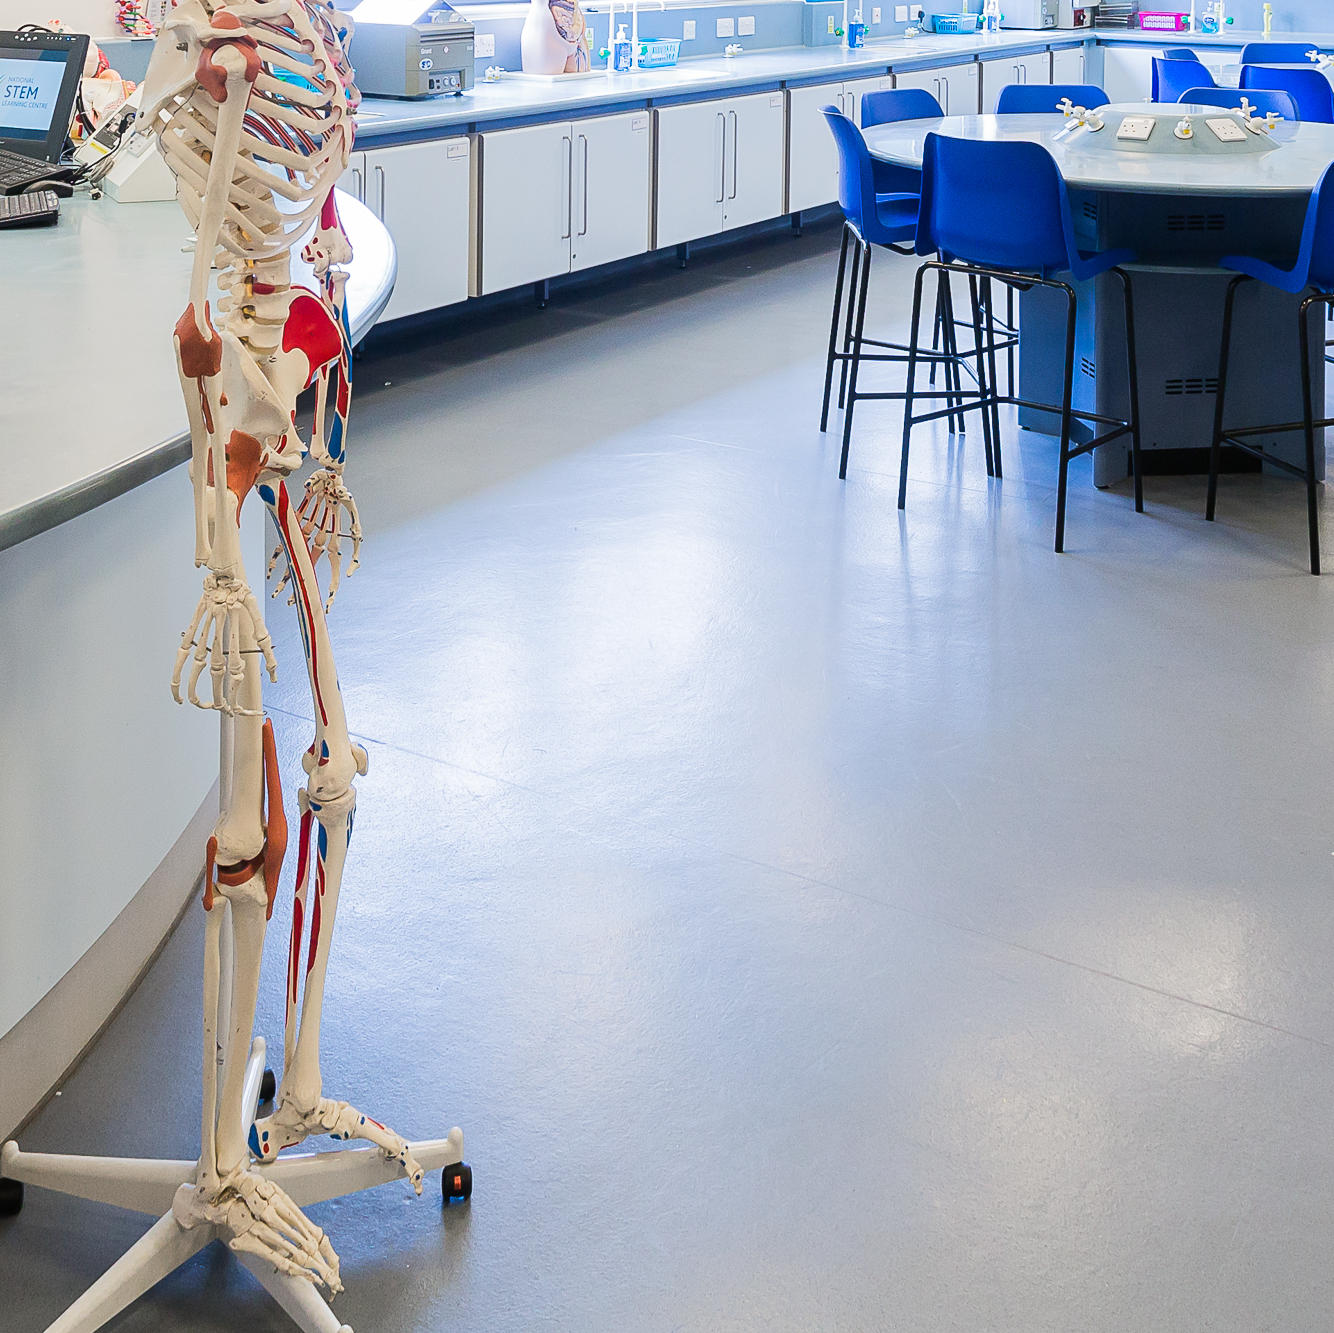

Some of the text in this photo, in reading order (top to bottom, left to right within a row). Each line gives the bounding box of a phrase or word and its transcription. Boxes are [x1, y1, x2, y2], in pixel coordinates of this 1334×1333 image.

[7, 76, 35, 84] NATIONAL
[4, 84, 39, 100] STEM
[1, 99, 49, 110] LEARNING CENTRE
